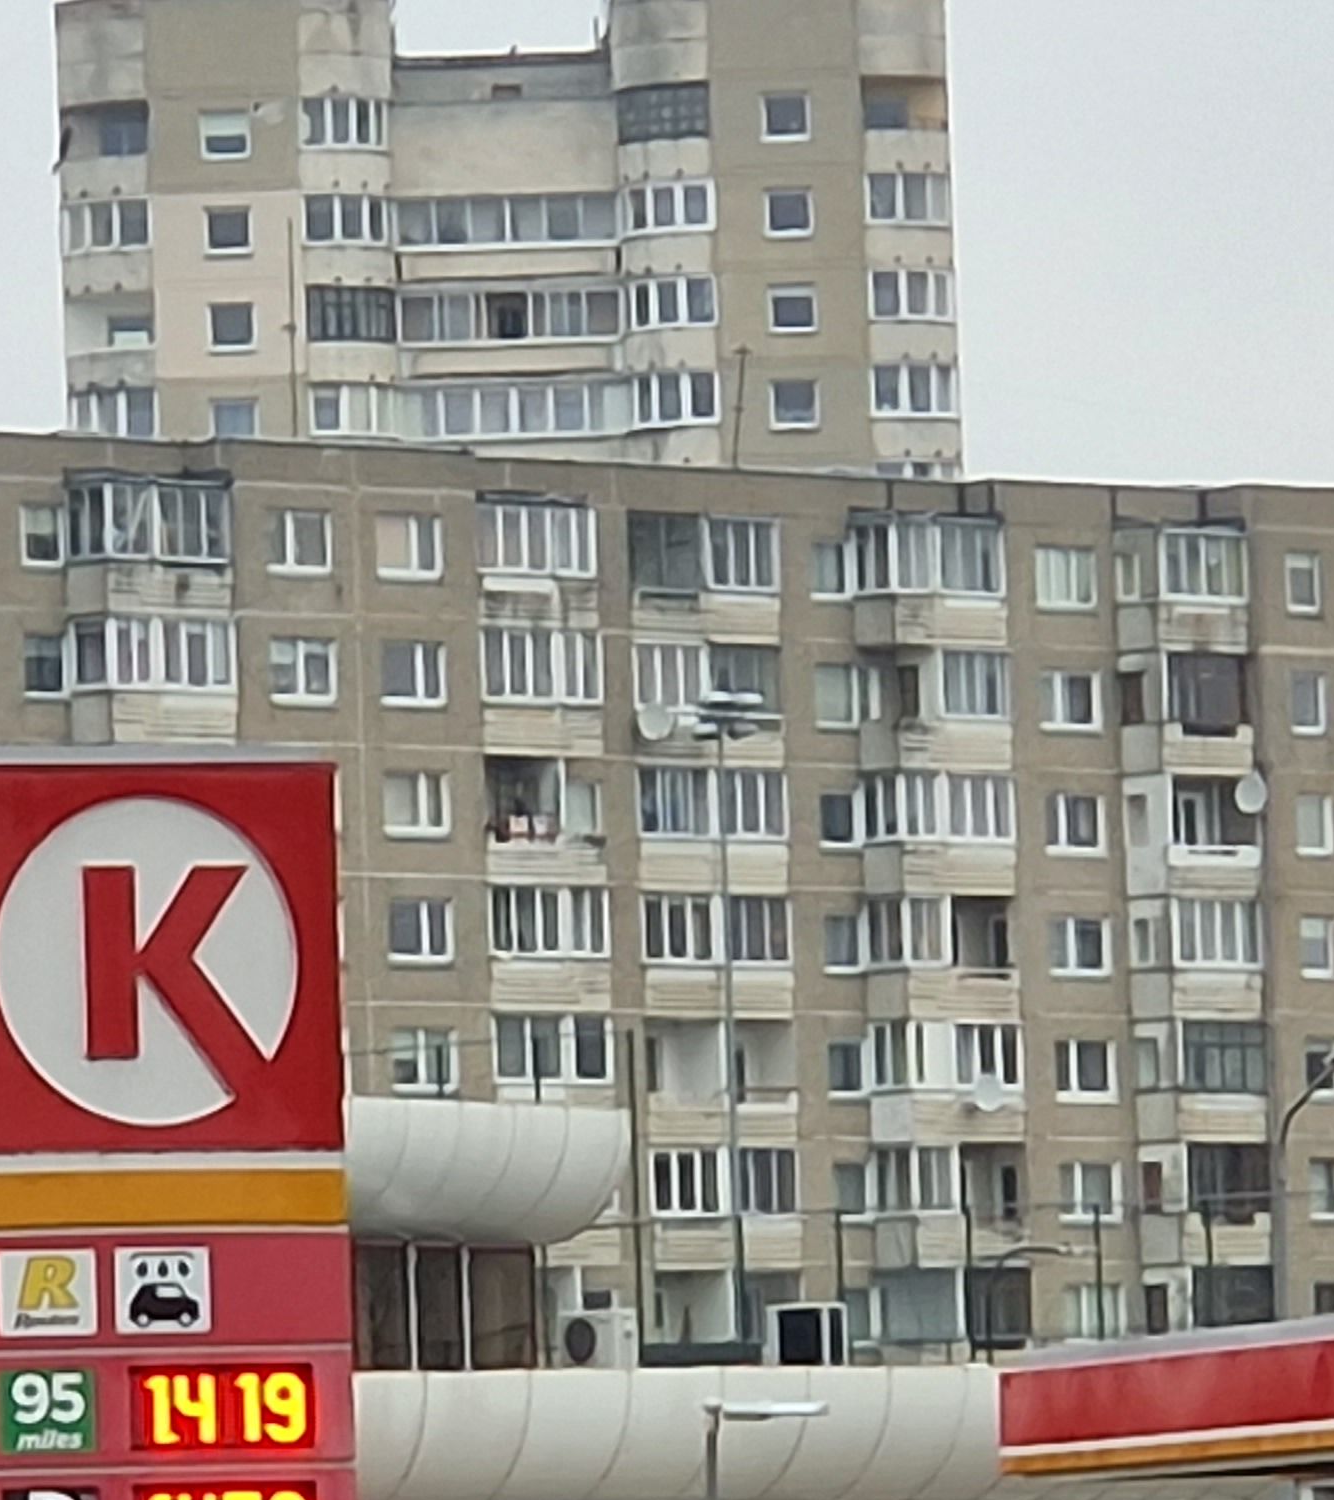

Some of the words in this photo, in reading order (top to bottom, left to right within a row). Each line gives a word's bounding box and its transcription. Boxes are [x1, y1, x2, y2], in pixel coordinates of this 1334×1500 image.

[17, 1254, 80, 1311] R
[11, 1371, 86, 1425] 95
[17, 1428, 84, 1451] miles
